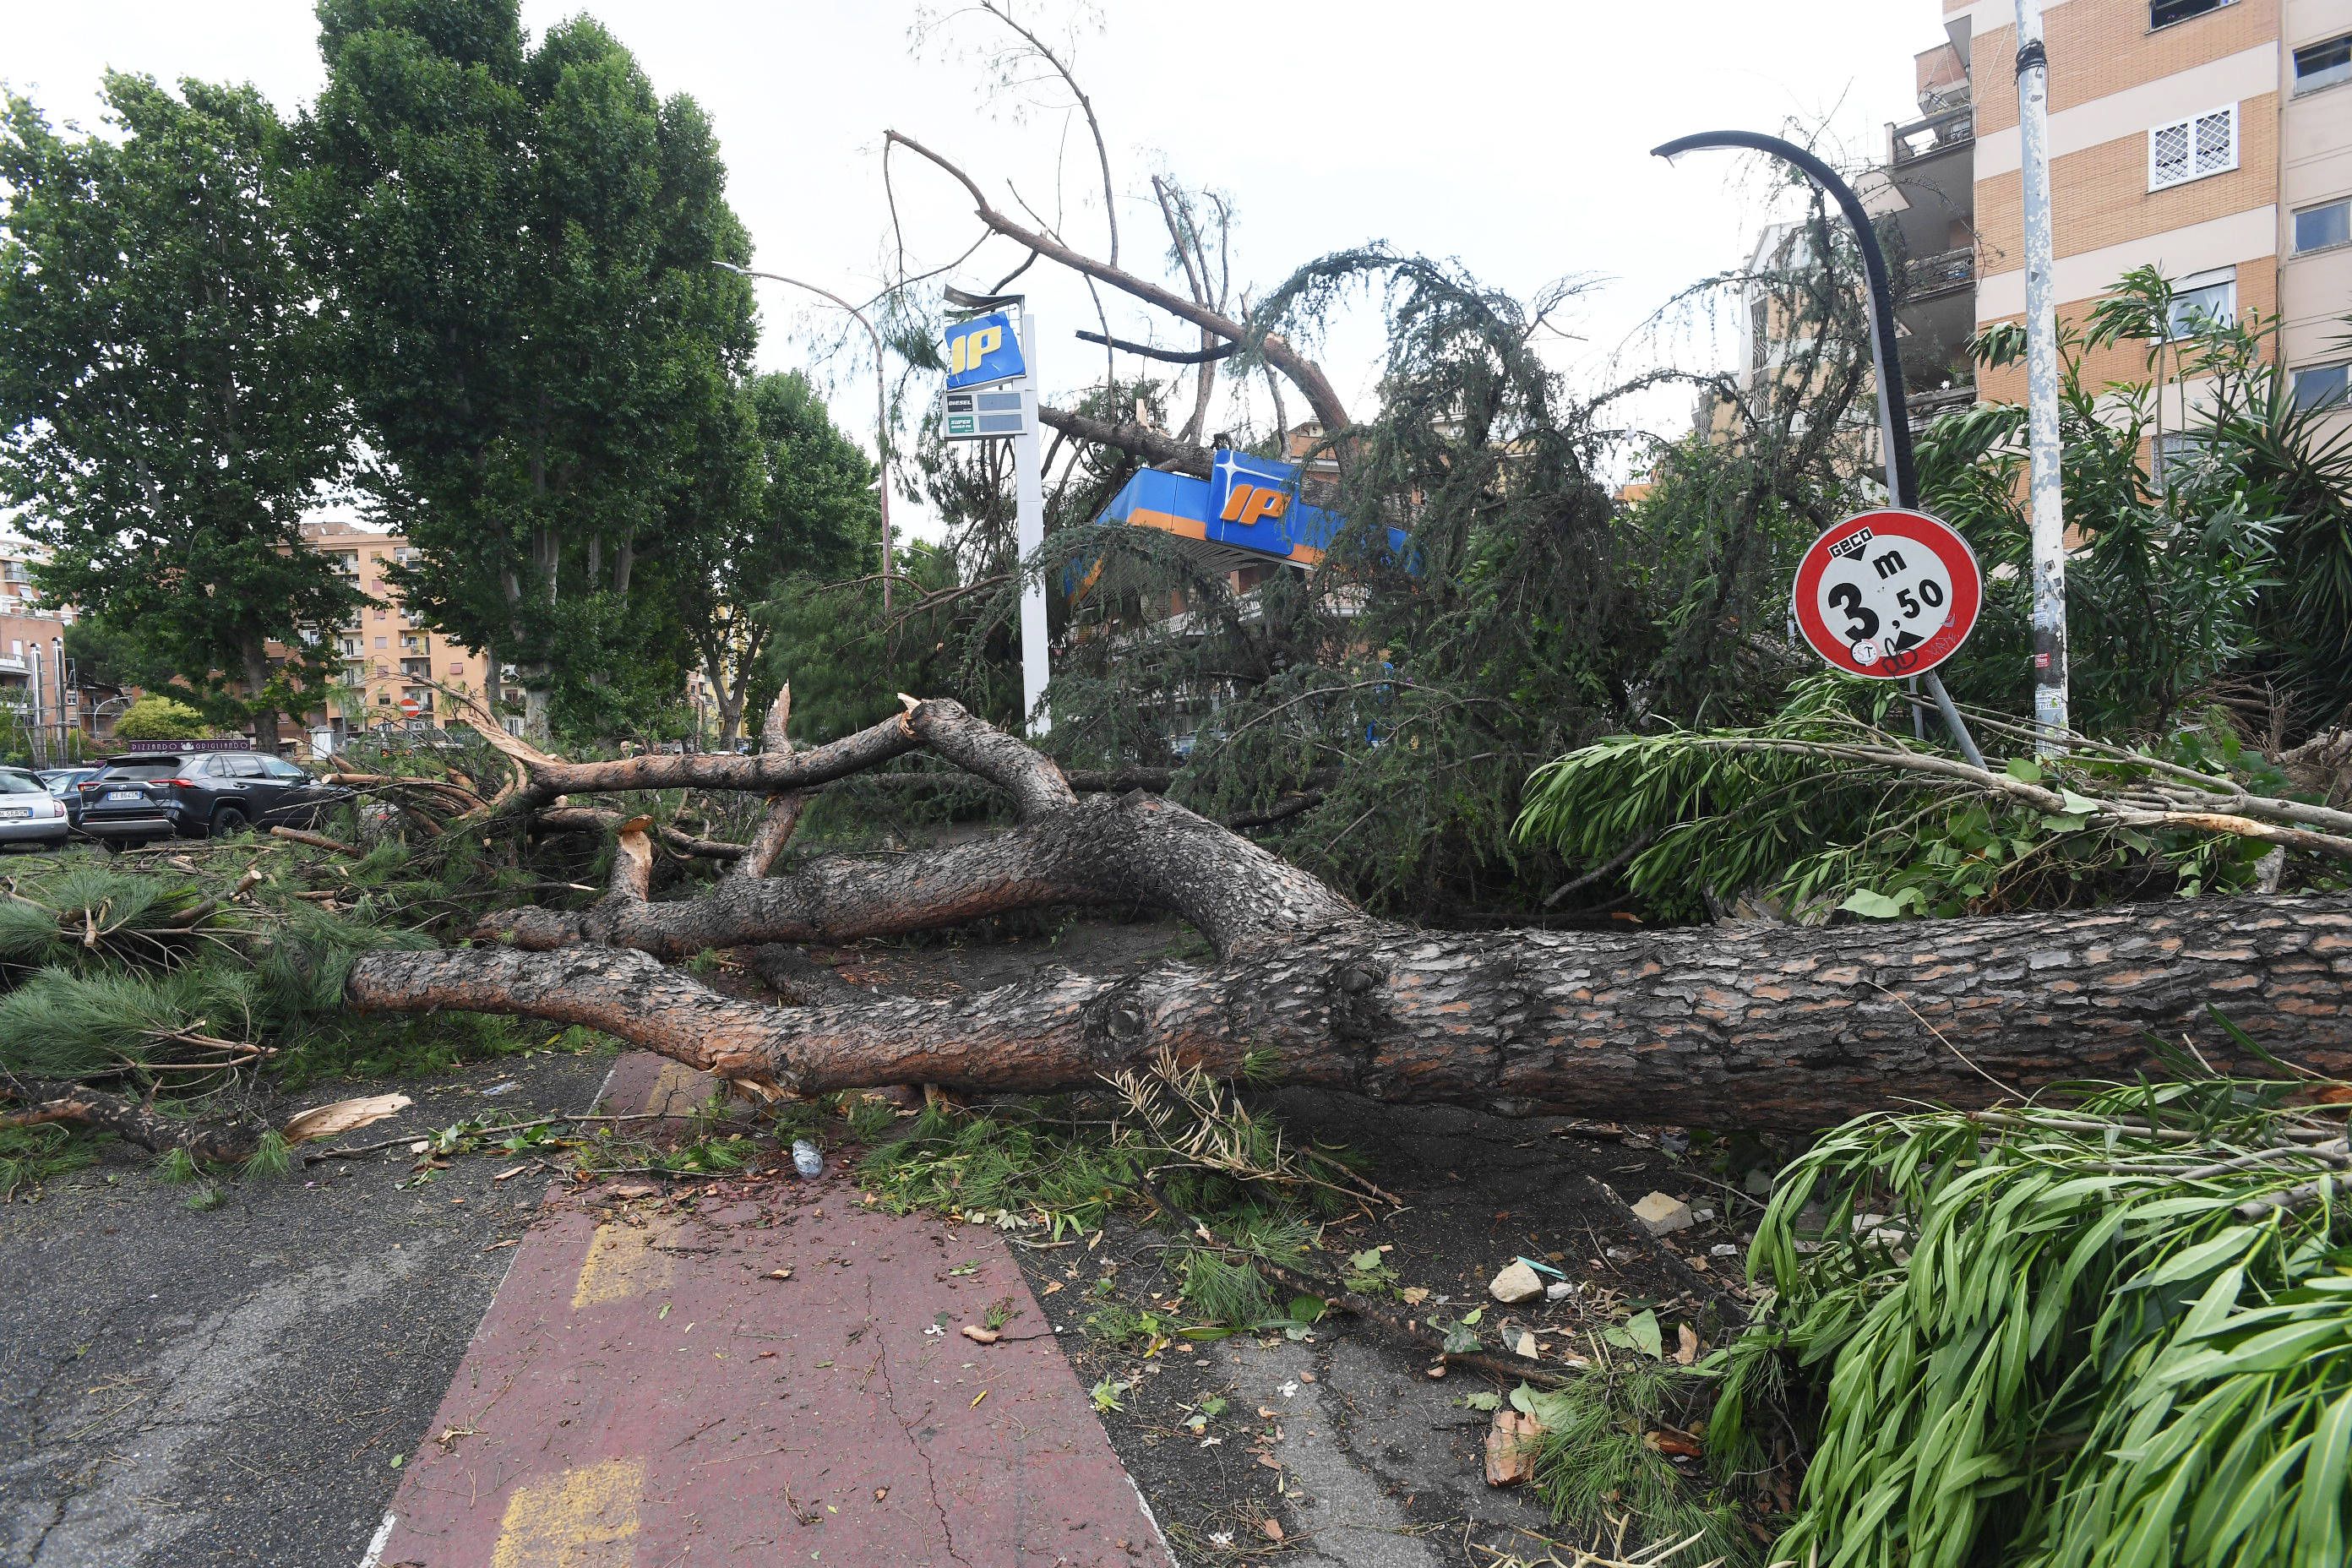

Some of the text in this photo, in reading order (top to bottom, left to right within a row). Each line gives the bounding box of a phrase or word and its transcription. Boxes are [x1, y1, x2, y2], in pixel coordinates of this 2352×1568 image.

[951, 325, 1001, 375] IP
[1219, 484, 1293, 525] IP
[1872, 550, 1908, 580] m
